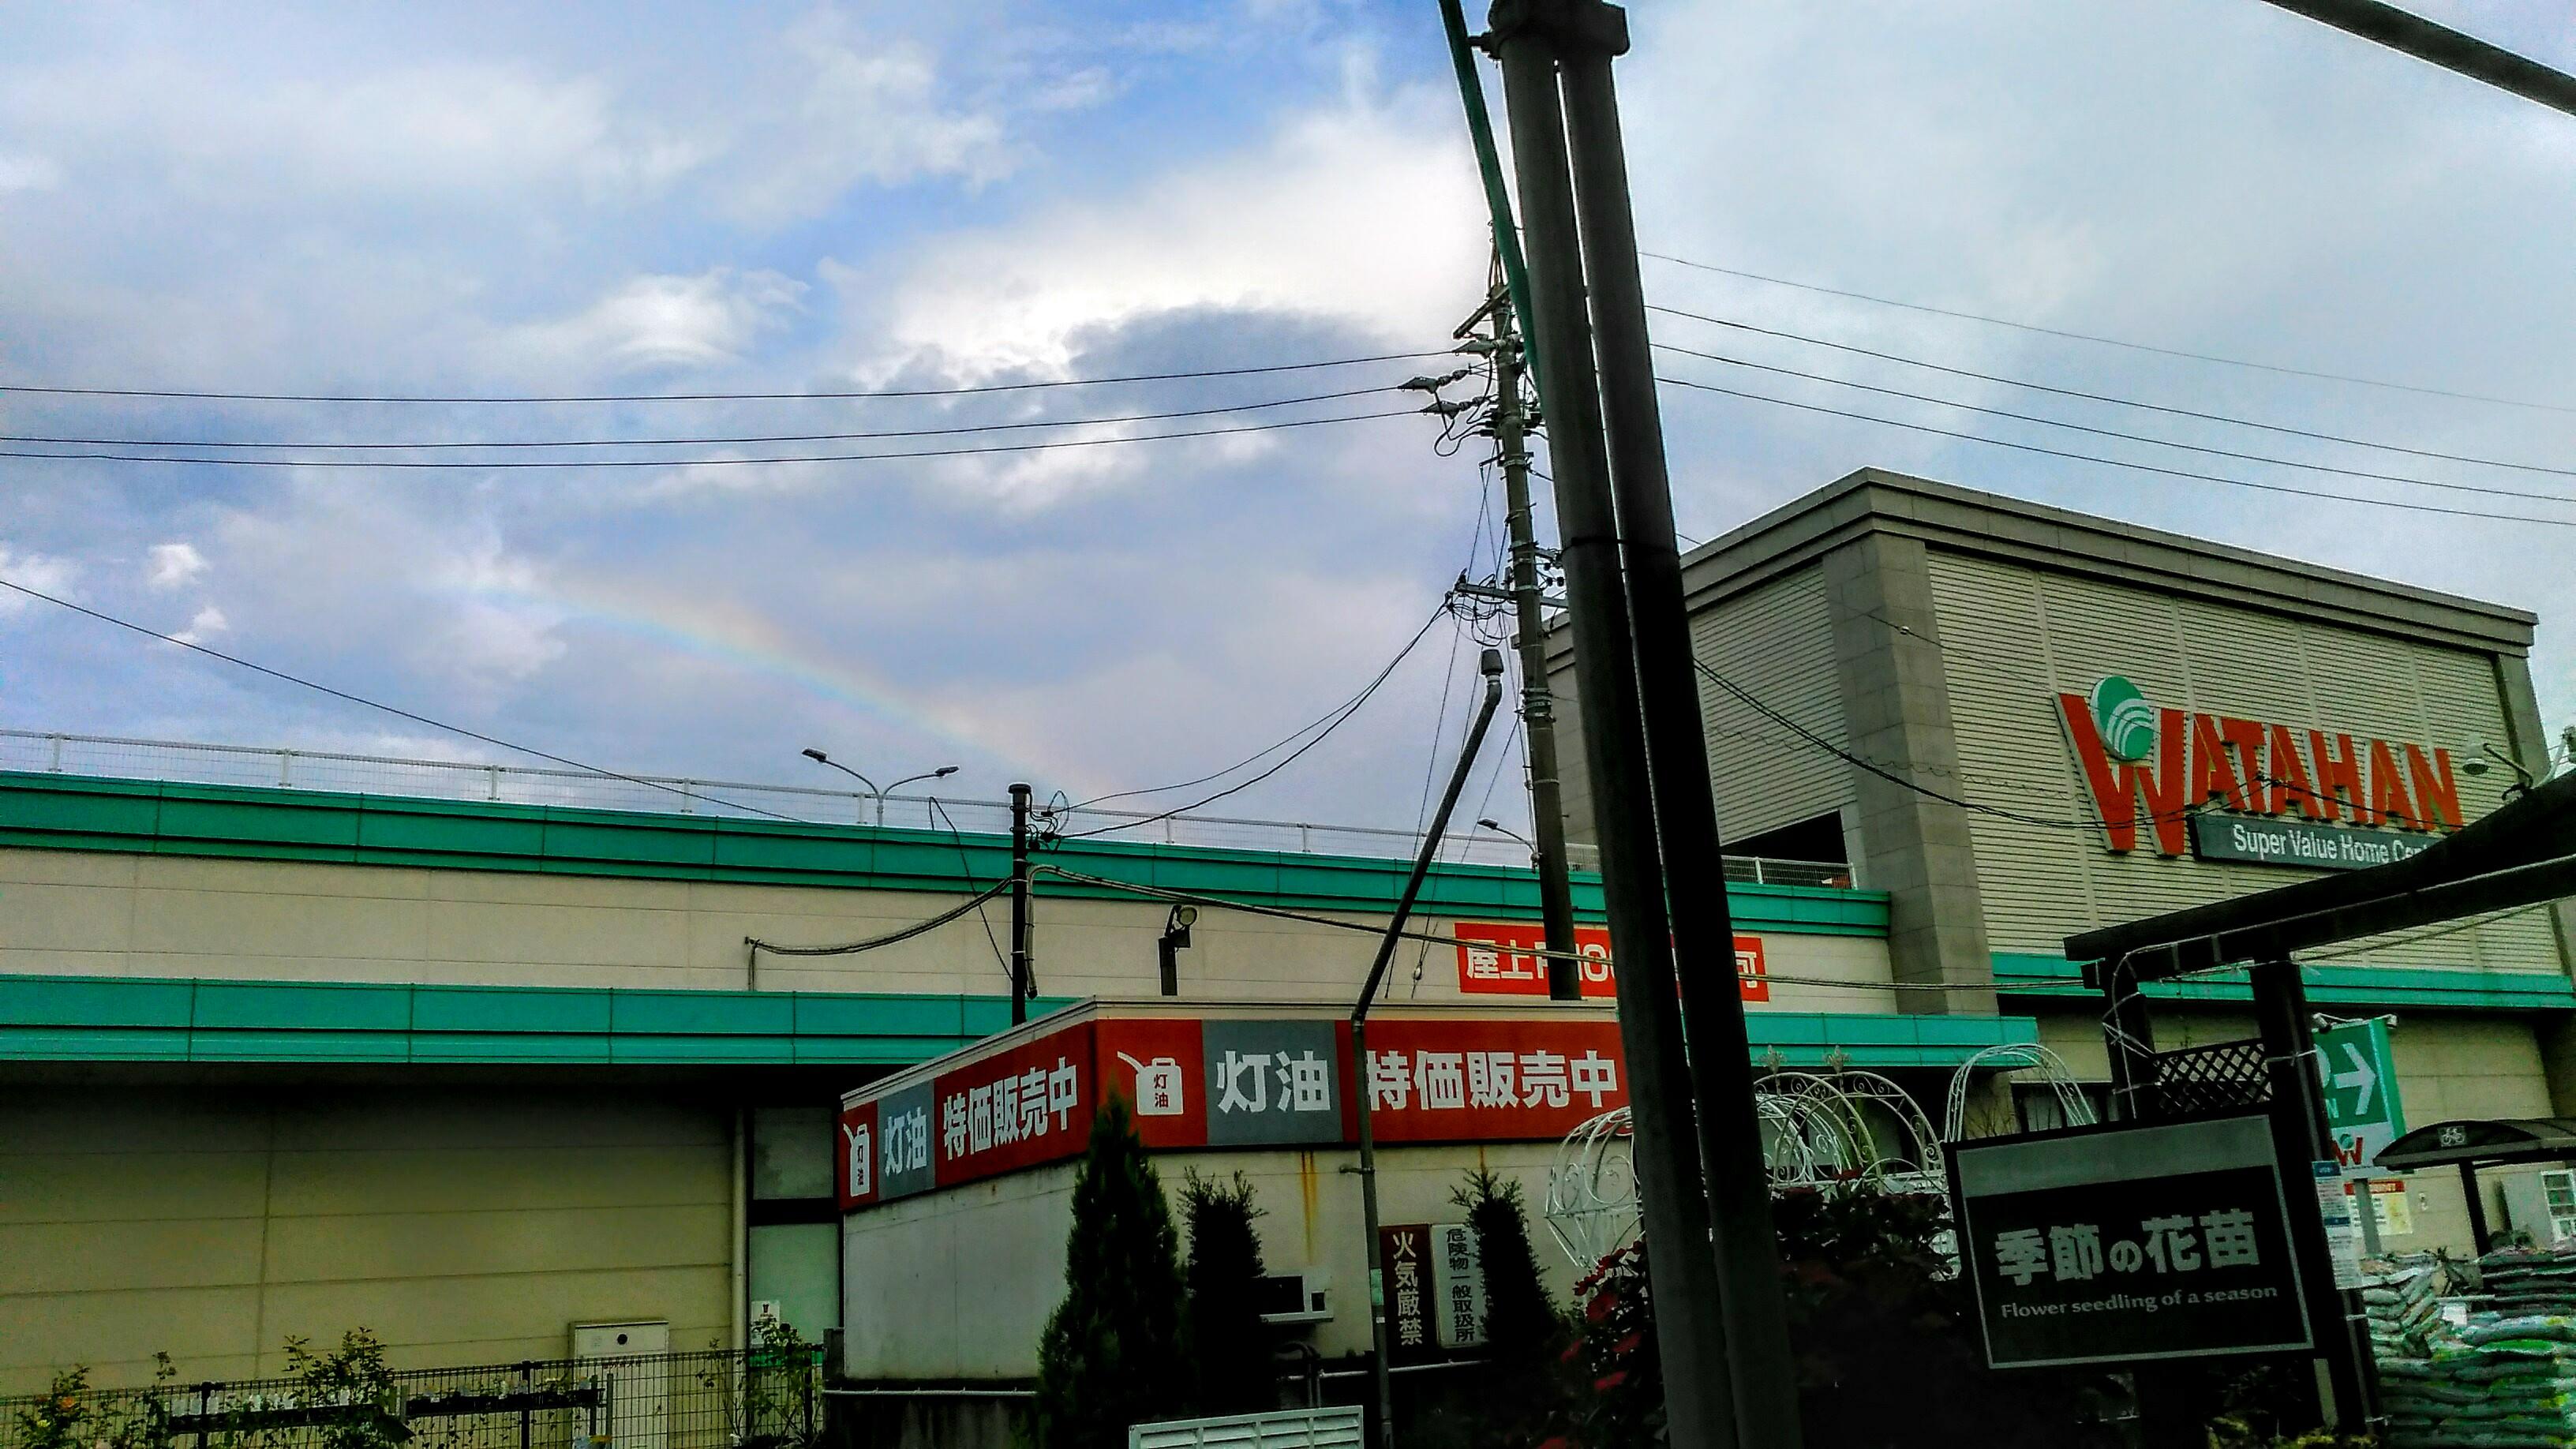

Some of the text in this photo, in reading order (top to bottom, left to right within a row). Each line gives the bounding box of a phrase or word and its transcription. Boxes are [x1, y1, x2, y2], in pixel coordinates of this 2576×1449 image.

[2053, 692, 2465, 857] WATAHAN
[2233, 824, 2286, 860] Super
[2289, 829, 2337, 859] Value
[2341, 834, 2390, 863] Home
[885, 1056, 1078, 1177] 灯油 特価販売中
[1153, 1073, 1169, 1108] 灯油
[1216, 1050, 1618, 1114] 灯油 特価販売中
[1446, 1228, 1476, 1342] 危険物一般取扱所
[1994, 1208, 2260, 1286] 季節の花苗
[1392, 1230, 1423, 1346] 火気厳禁
[2001, 1286, 2278, 1318] Flower seedling of a season
